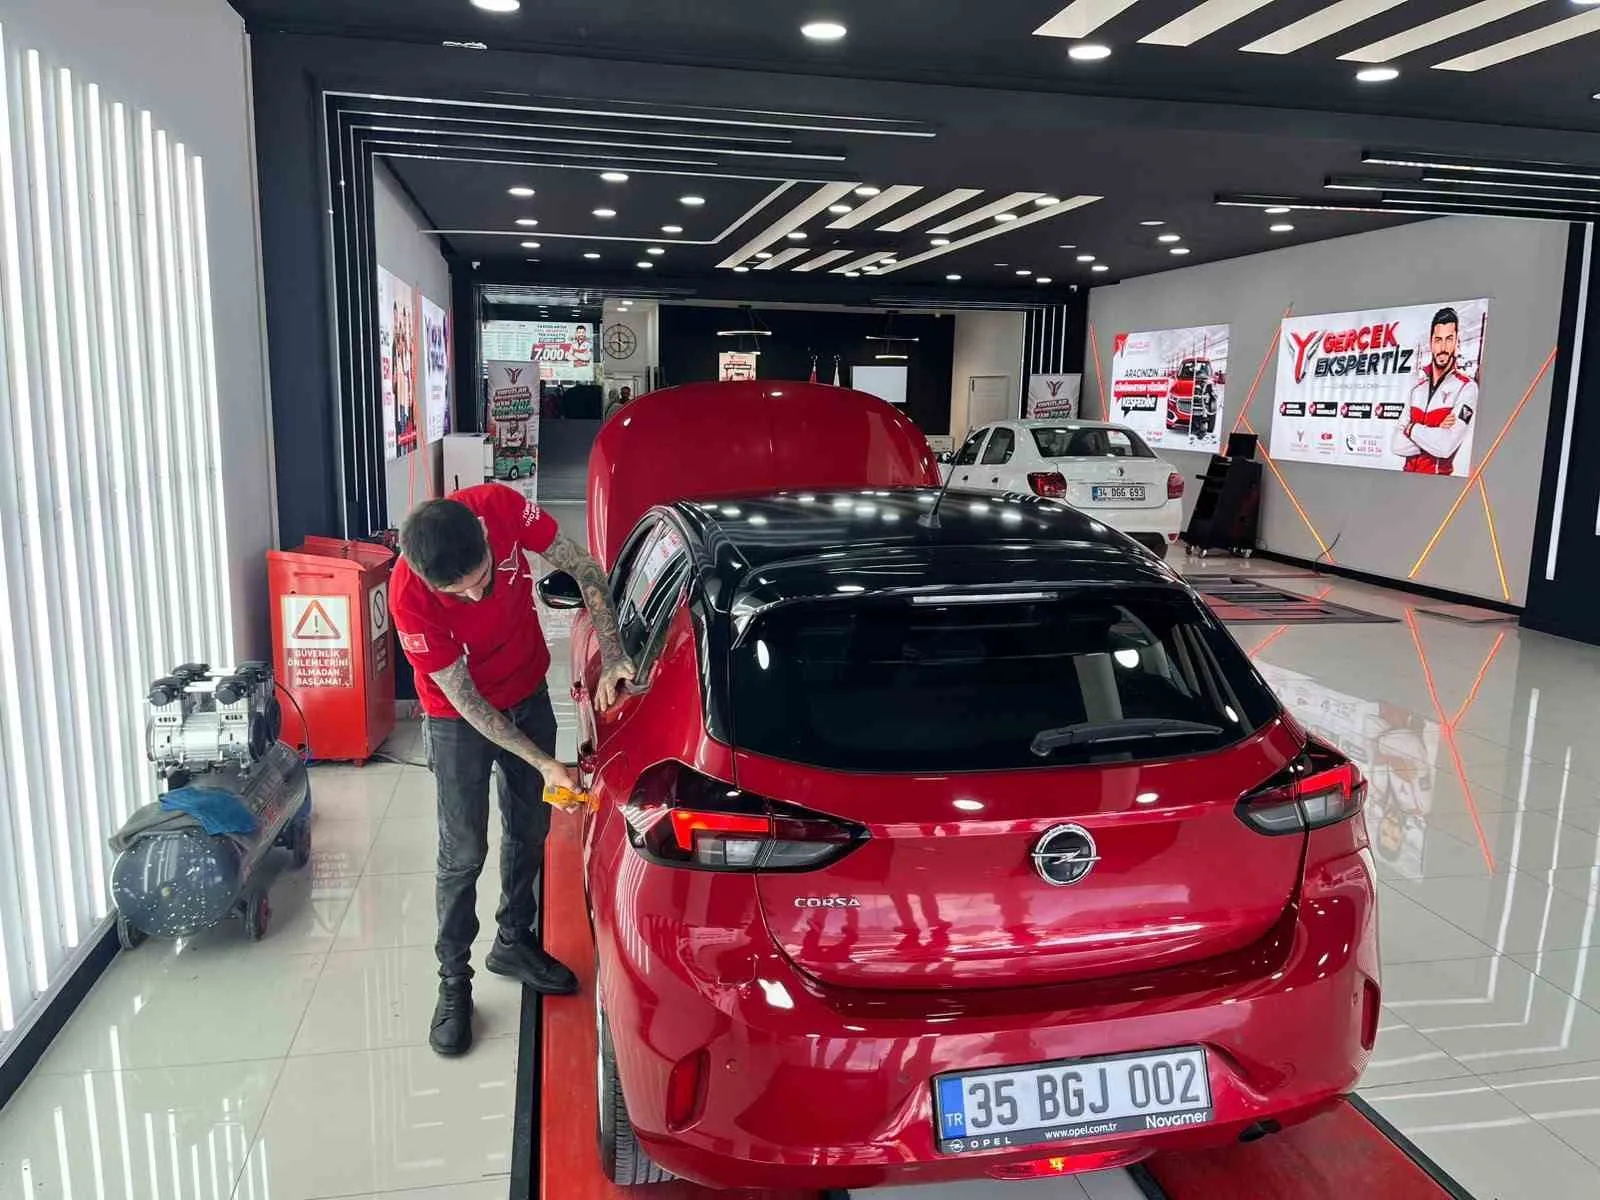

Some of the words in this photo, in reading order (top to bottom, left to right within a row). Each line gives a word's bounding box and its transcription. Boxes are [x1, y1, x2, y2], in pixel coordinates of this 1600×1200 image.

[1323, 321, 1399, 353] GERÇEK
[1314, 344, 1414, 378] EKSPERTİZ
[794, 897, 862, 909] CORSA
[968, 1079, 1018, 1129] 35
[1036, 1067, 1110, 1121] BGJ
[1128, 1057, 1200, 1109] 002
[945, 1112, 963, 1128] TR
[1145, 1111, 1208, 1129] Novamer
[1045, 1121, 1118, 1140] www.opel.com.tr
[970, 1136, 1011, 1149] OPEL
